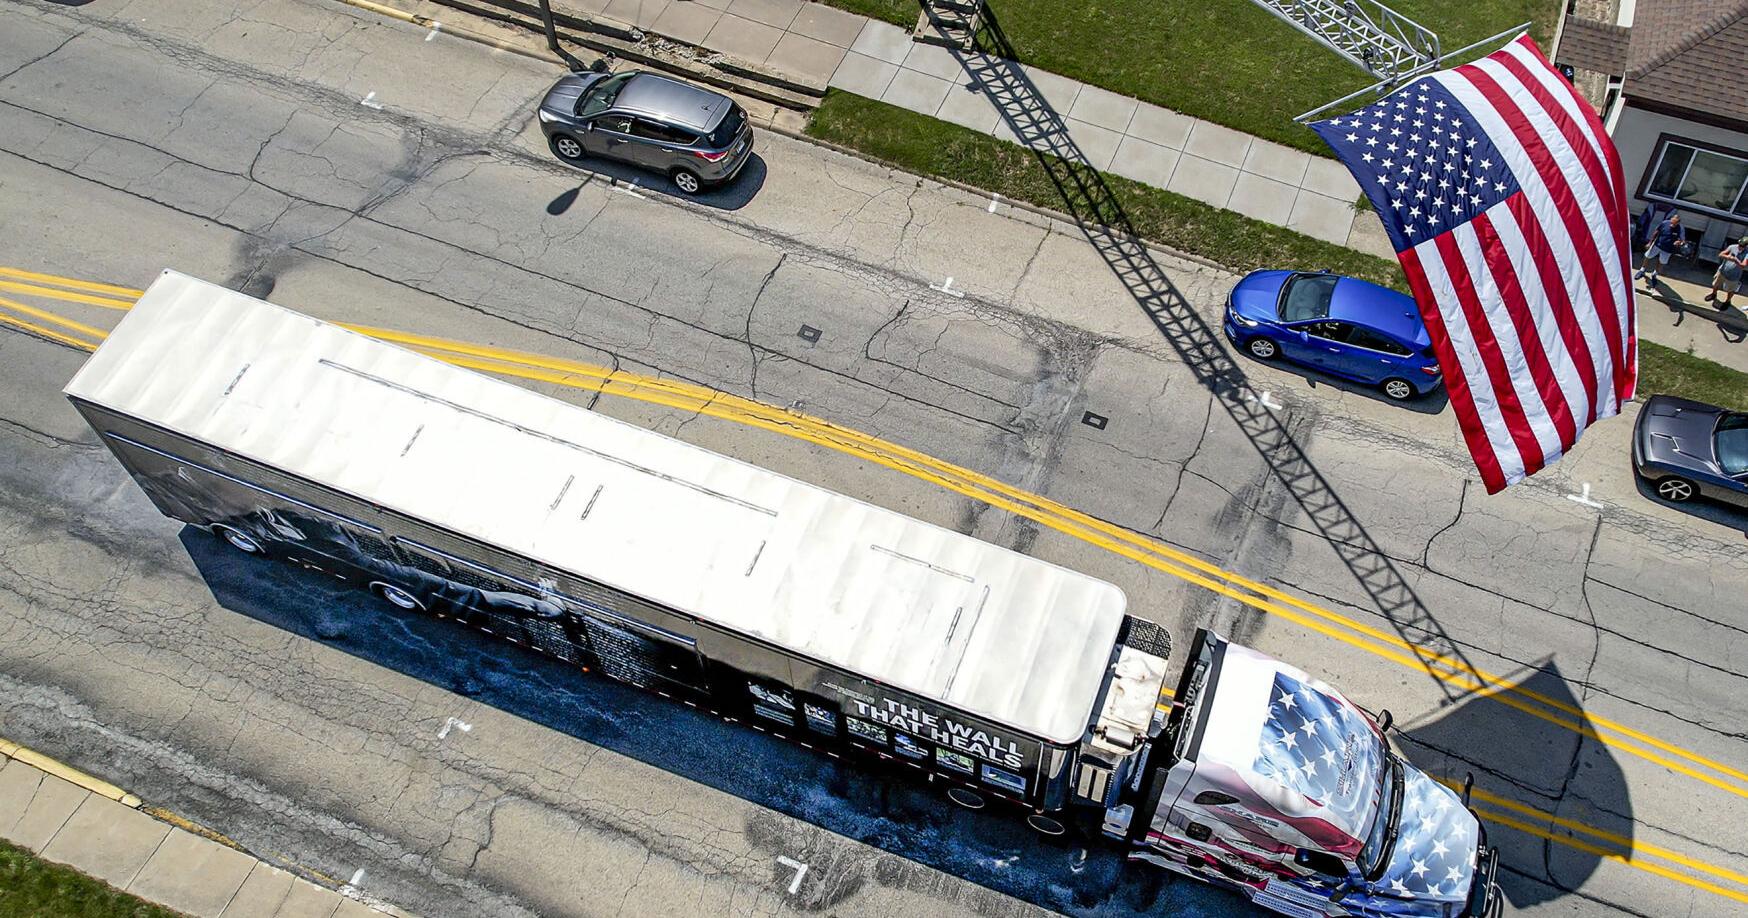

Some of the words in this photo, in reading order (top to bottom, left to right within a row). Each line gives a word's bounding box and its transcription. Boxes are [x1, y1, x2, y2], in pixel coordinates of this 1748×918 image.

[853, 699, 924, 734] THAT
[930, 727, 1023, 769] HEALS
[883, 697, 940, 729] THE
[945, 718, 1024, 758] WALL
